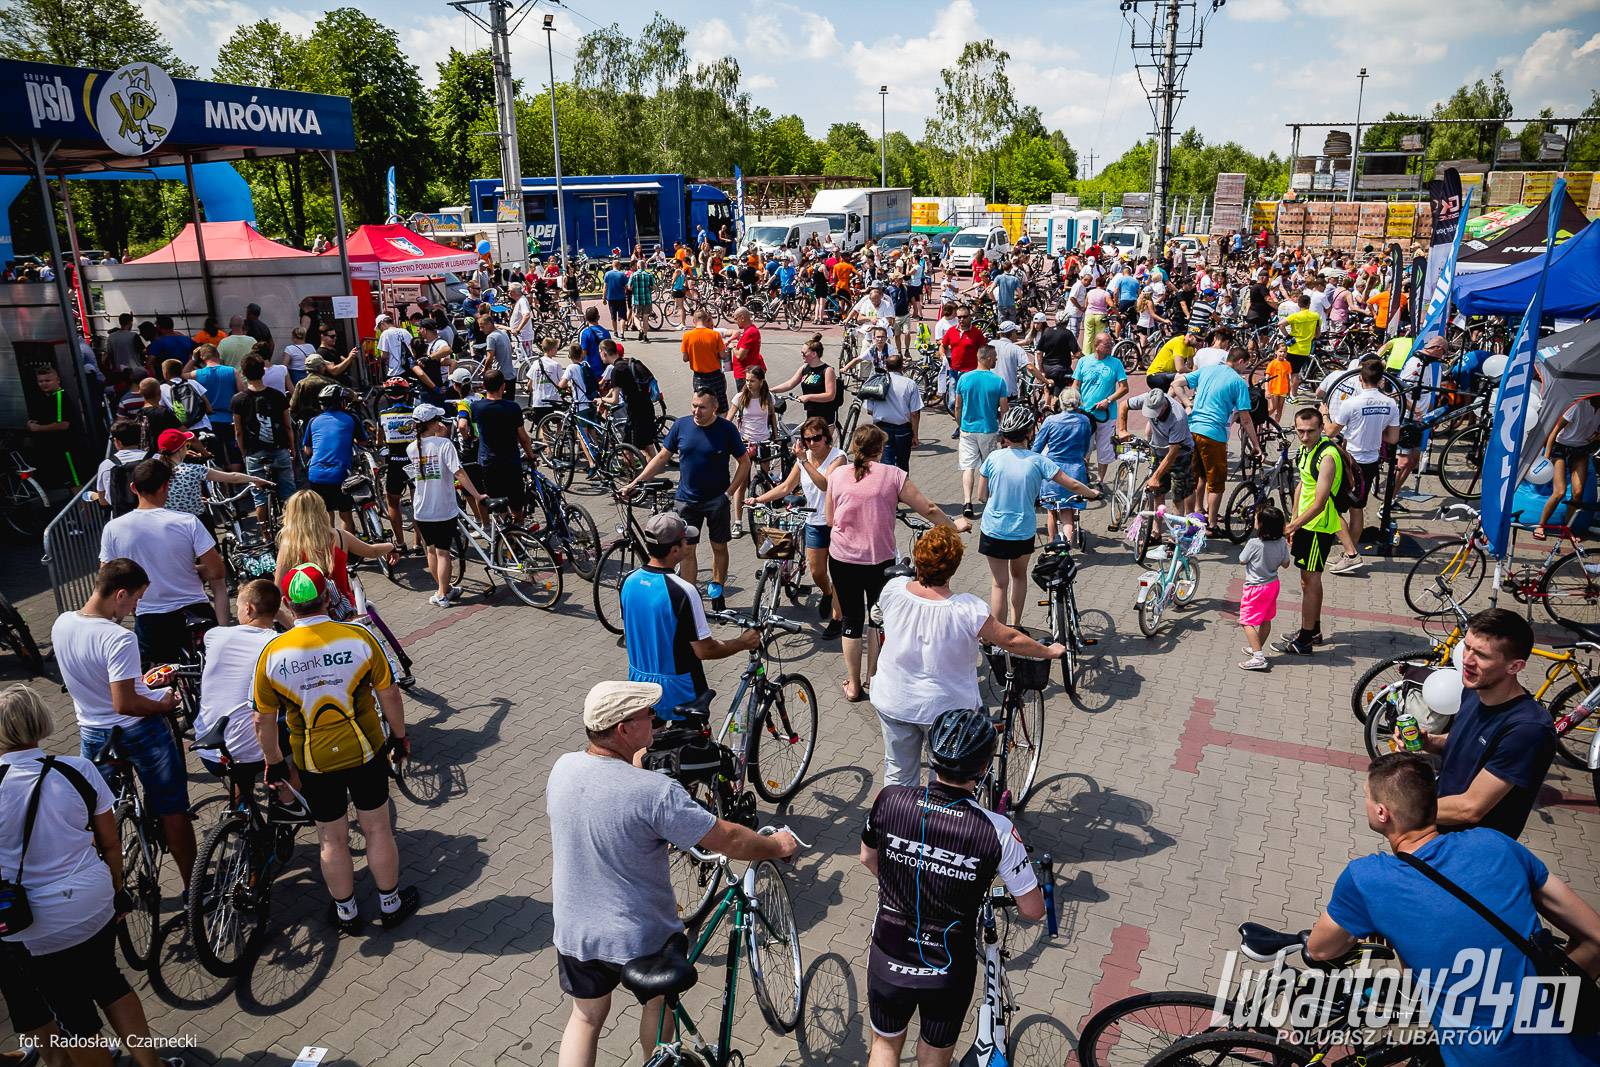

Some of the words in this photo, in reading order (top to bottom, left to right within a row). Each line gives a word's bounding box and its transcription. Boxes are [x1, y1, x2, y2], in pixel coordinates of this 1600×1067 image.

[23, 72, 50, 82] GRUPA
[25, 76, 75, 128] psb
[204, 95, 322, 135] MRÓWKA
[528, 224, 557, 238] APEI
[381, 263, 416, 274] STAROSTWO
[416, 261, 445, 270] POWIATOWE
[450, 258, 478, 267] LUBARTOWIE
[291, 655, 322, 674] Bank
[916, 799, 964, 818] SHIMANO
[886, 833, 981, 870] TREK
[1012, 856, 1030, 876] TR
[887, 961, 948, 976] TREK
